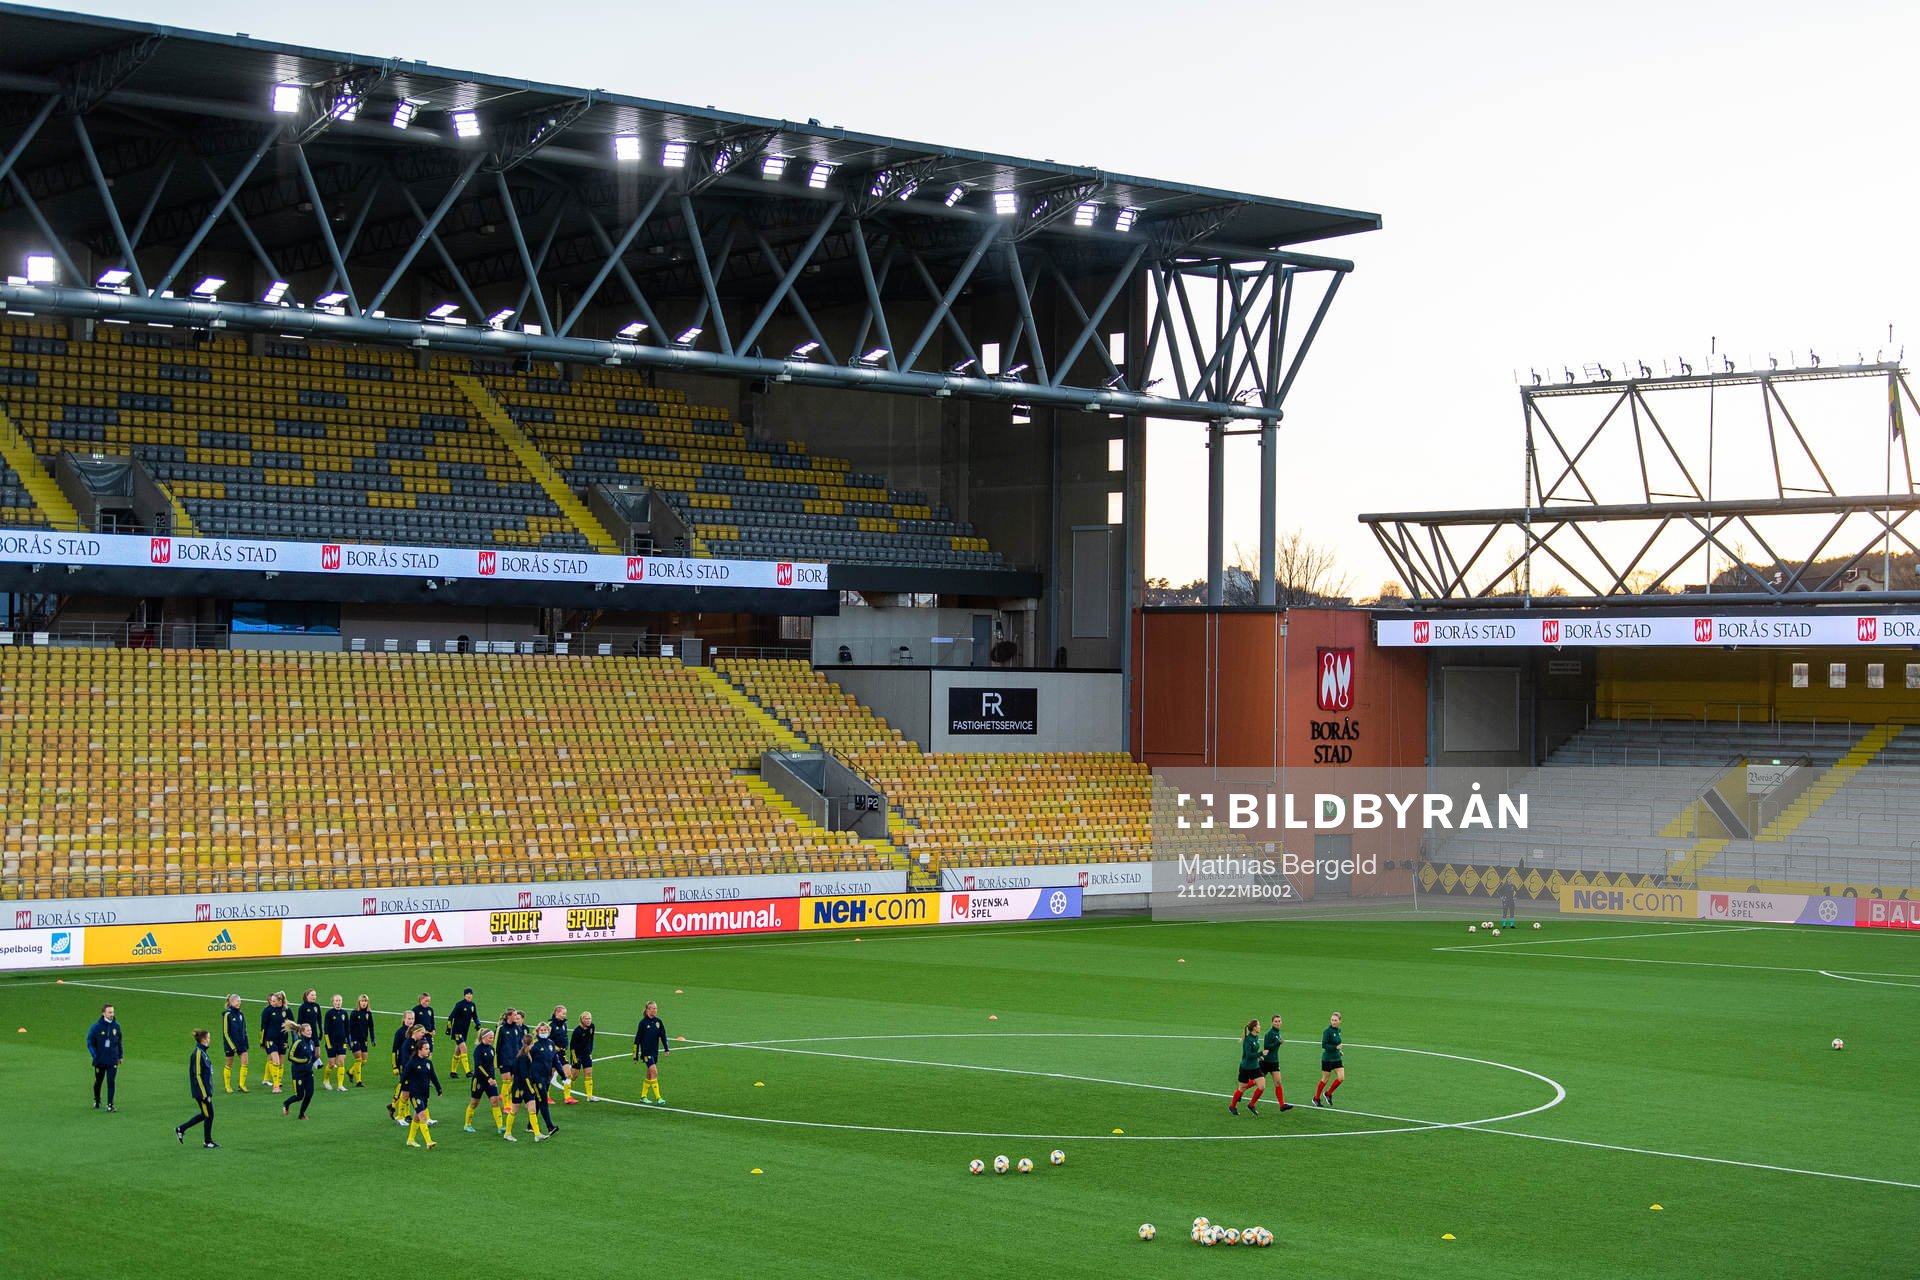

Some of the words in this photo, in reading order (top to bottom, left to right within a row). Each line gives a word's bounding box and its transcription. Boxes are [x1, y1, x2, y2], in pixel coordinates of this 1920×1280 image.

[57, 540, 100, 556] STAD
[177, 541, 232, 562] BORÅS
[237, 546, 277, 563] STAD
[347, 548, 398, 567] BORÅS
[402, 552, 439, 569] STAD
[502, 555, 549, 574] BORÅS
[553, 558, 588, 574] STAD
[648, 561, 693, 578] BORÅS
[696, 564, 730, 580] STAD
[1434, 622, 1478, 640] BORÅS
[1482, 625, 1516, 640] STAD
[1564, 620, 1612, 638] BORÅS
[1615, 624, 1652, 638] STAD
[1718, 619, 1768, 638] BORÅS
[1773, 623, 1812, 638] STAD
[982, 692, 1004, 716] FR
[952, 720, 1033, 730] FASTIGHETSSERVICE
[1310, 717, 1360, 740] BORÅS
[1314, 744, 1352, 764] STAD
[868, 798, 878, 809] P2
[978, 875, 1007, 890] BORÅS
[1008, 877, 1031, 888] STAD
[1091, 872, 1118, 886] BORÅS
[1120, 873, 1142, 884] STAD
[679, 886, 714, 901] BORÅS
[716, 888, 740, 900] STAD
[814, 882, 847, 896] BORÅS
[848, 882, 872, 894] STAD
[381, 897, 420, 912] BORÅS
[422, 898, 450, 911] STAD
[536, 892, 572, 907] BORÅS
[574, 893, 600, 906] STAD
[972, 898, 1009, 908] SVENSKA
[1731, 900, 1774, 910] SVENSKA
[37, 912, 81, 926] BORÅS
[84, 911, 116, 924] STAD
[214, 904, 256, 920] BORÅS
[258, 905, 290, 918] STAD
[567, 908, 618, 930] SPORT
[971, 908, 992, 918] SPEL
[1731, 910, 1754, 918] SPEL
[1872, 904, 1920, 925] BAU
[490, 910, 542, 934] SPORT
[304, 923, 345, 949] ICA
[405, 918, 444, 944] ICA
[492, 934, 540, 943] BLADET
[568, 930, 616, 939] BLADET
[132, 946, 162, 956] adidas
[208, 942, 236, 952] adidas
